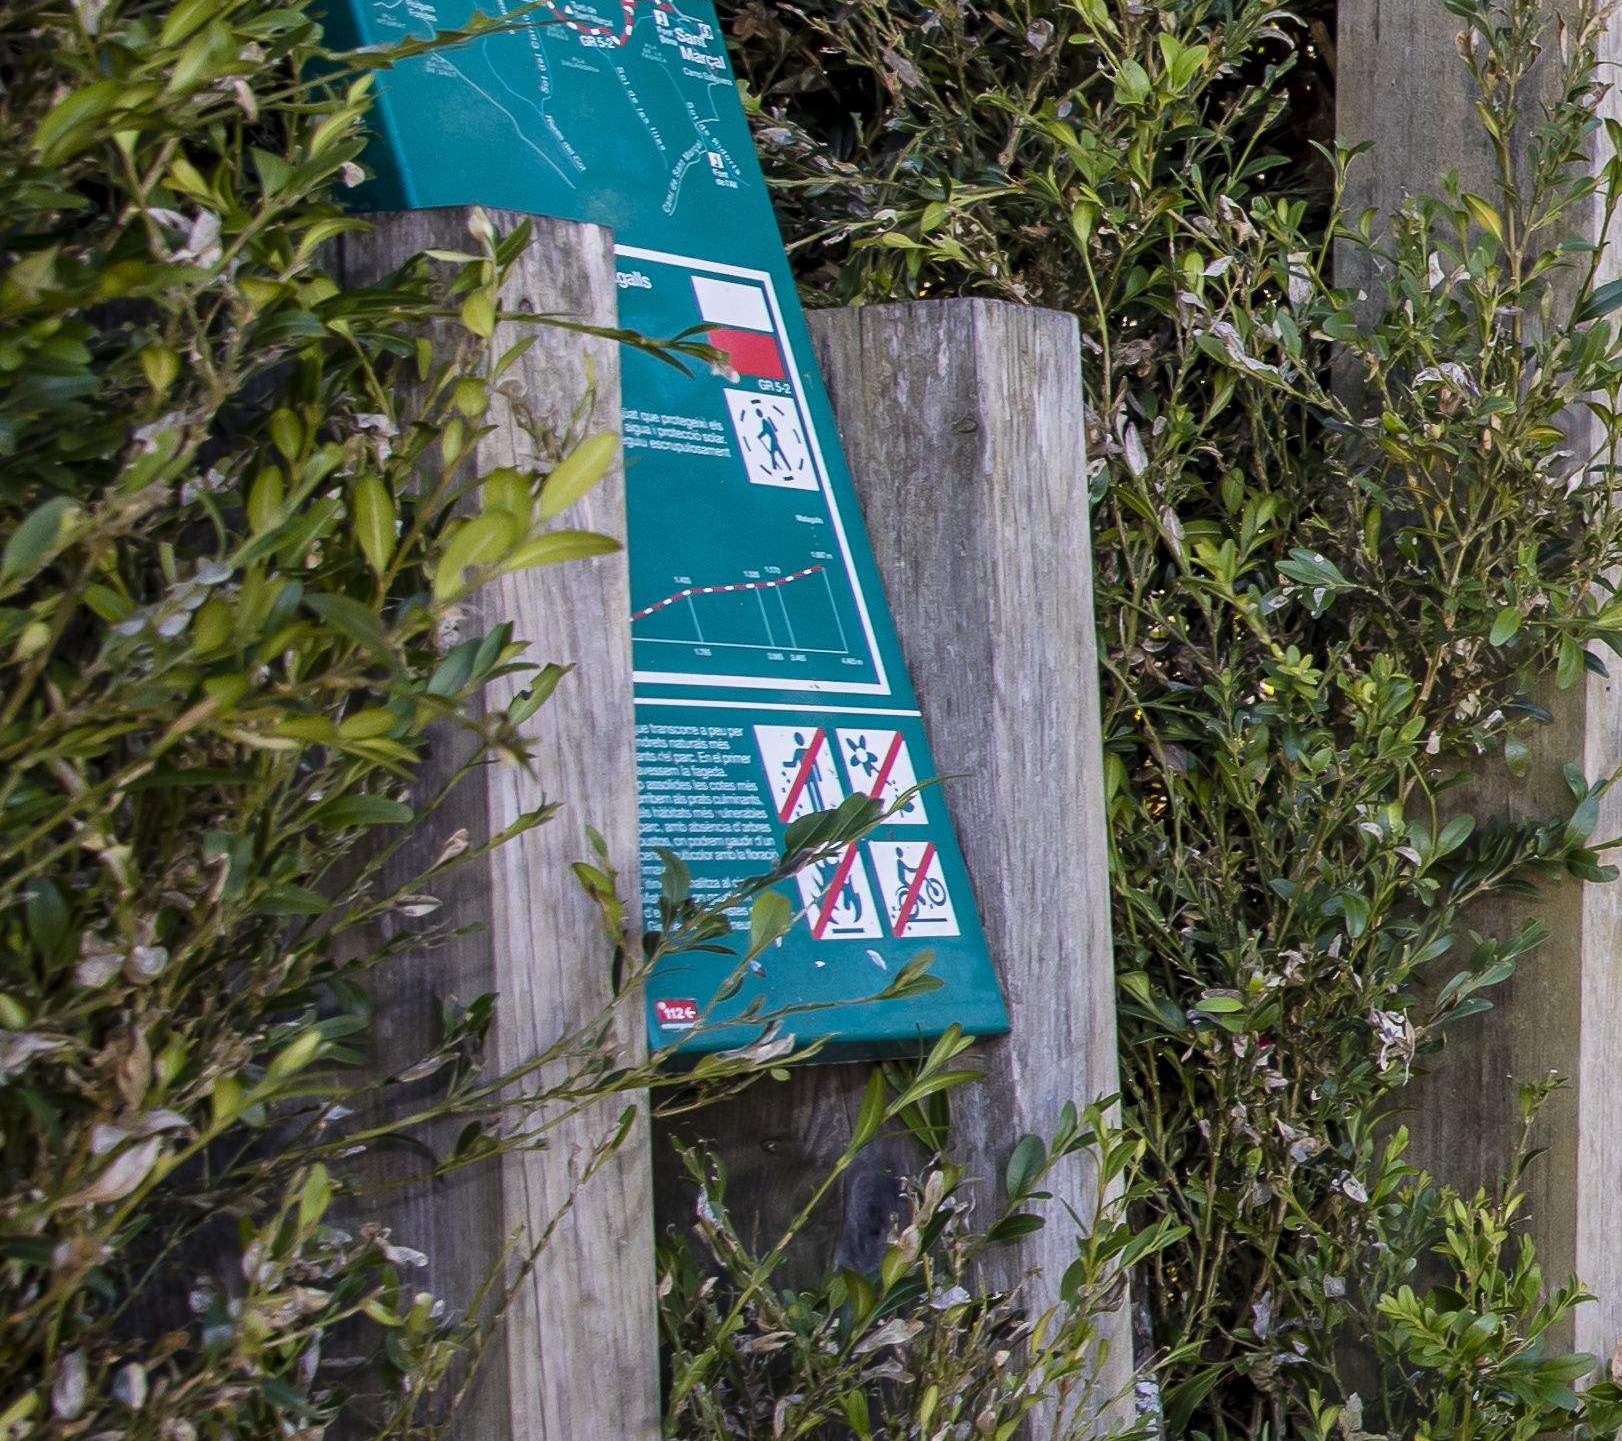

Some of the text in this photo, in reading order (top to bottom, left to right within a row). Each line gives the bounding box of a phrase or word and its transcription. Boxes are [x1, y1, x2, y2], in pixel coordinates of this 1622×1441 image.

[674, 27, 707, 48] Sant
[679, 46, 726, 70] Marçal
[616, 271, 652, 289] galls
[758, 379, 792, 395] GR 5-2
[728, 728, 743, 738] per
[664, 1007, 685, 1020] 112
